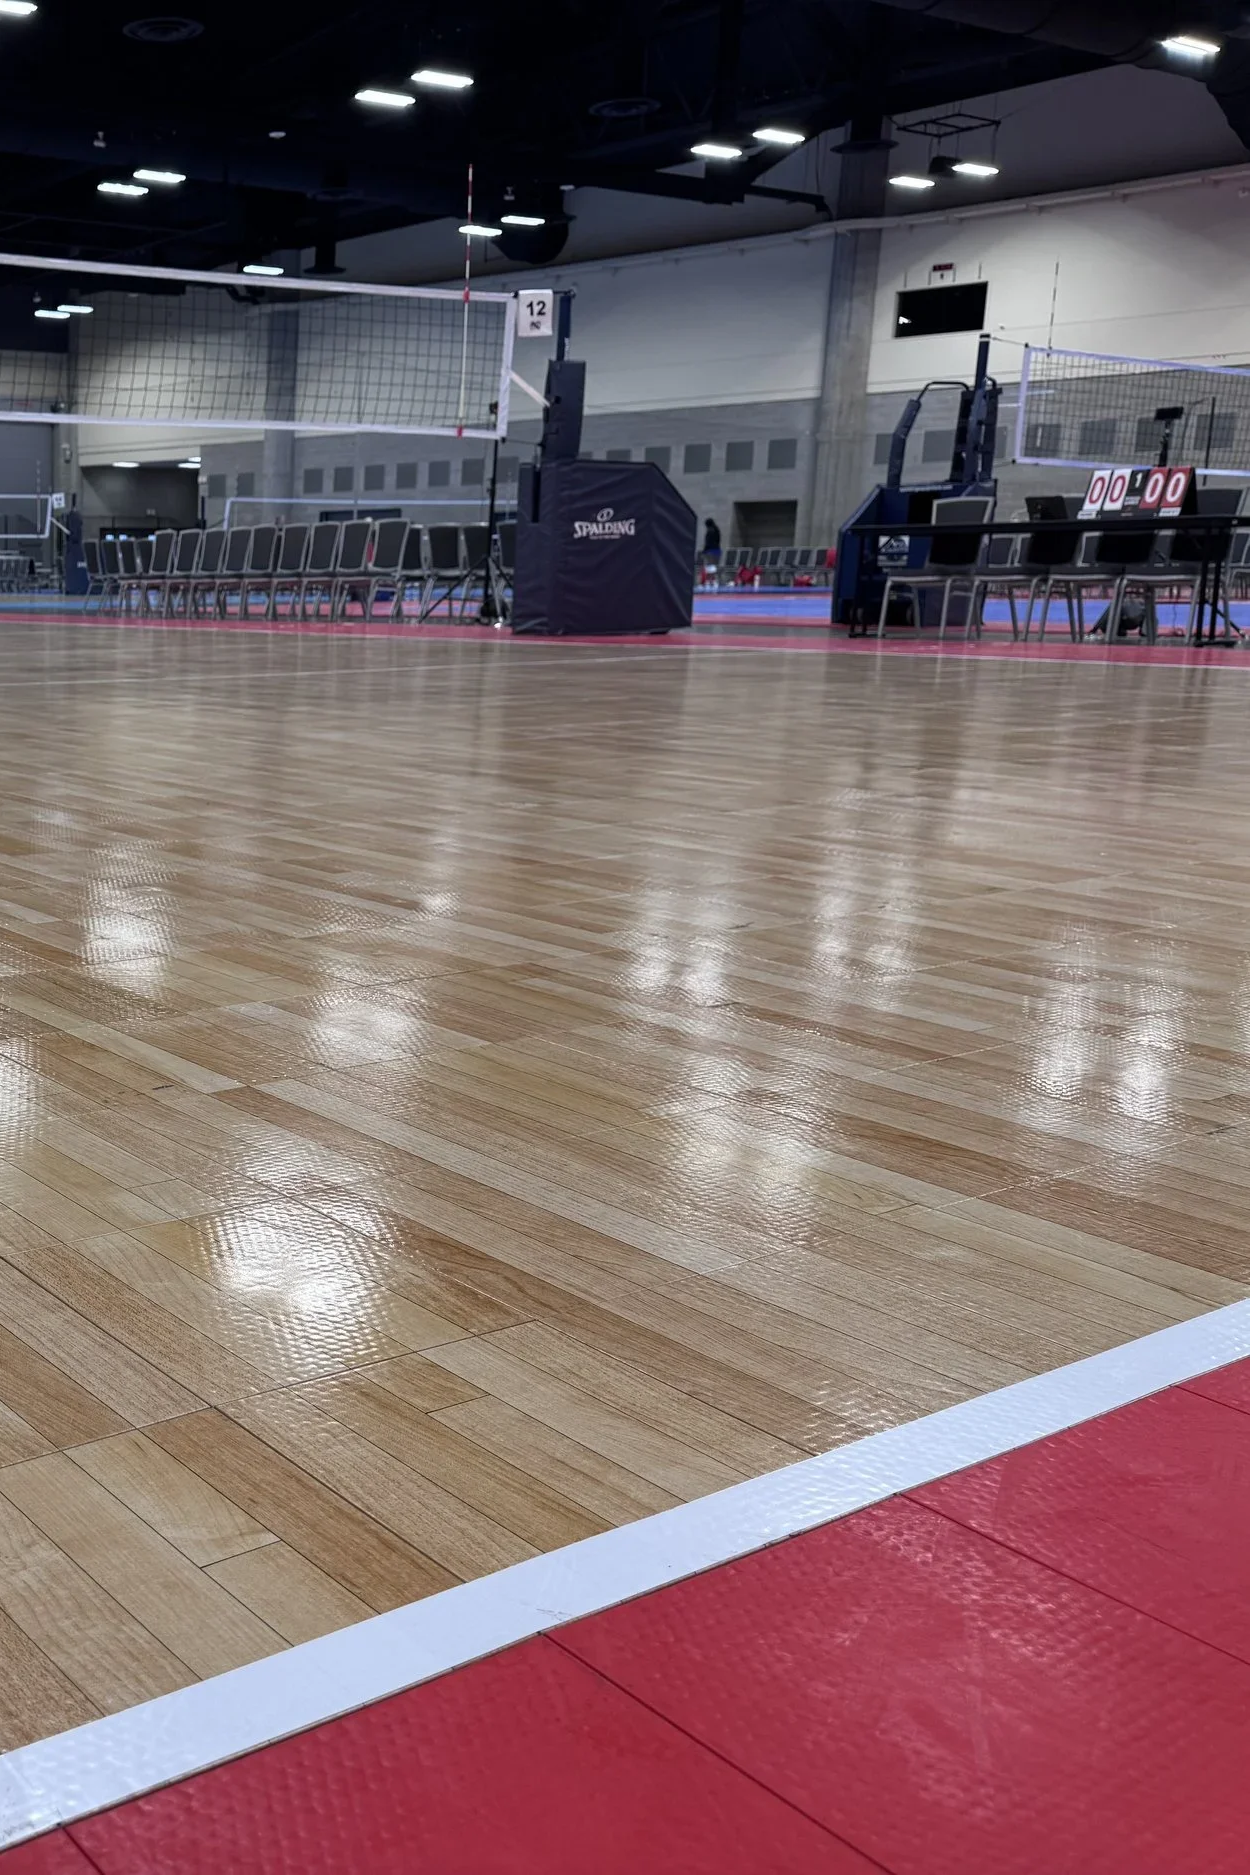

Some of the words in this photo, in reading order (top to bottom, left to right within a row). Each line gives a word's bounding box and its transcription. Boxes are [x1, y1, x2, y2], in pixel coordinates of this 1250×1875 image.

[526, 300, 546, 316] 12
[1088, 475, 1127, 504] 00
[1145, 472, 1186, 503] 00
[573, 518, 636, 539] SPALDING
